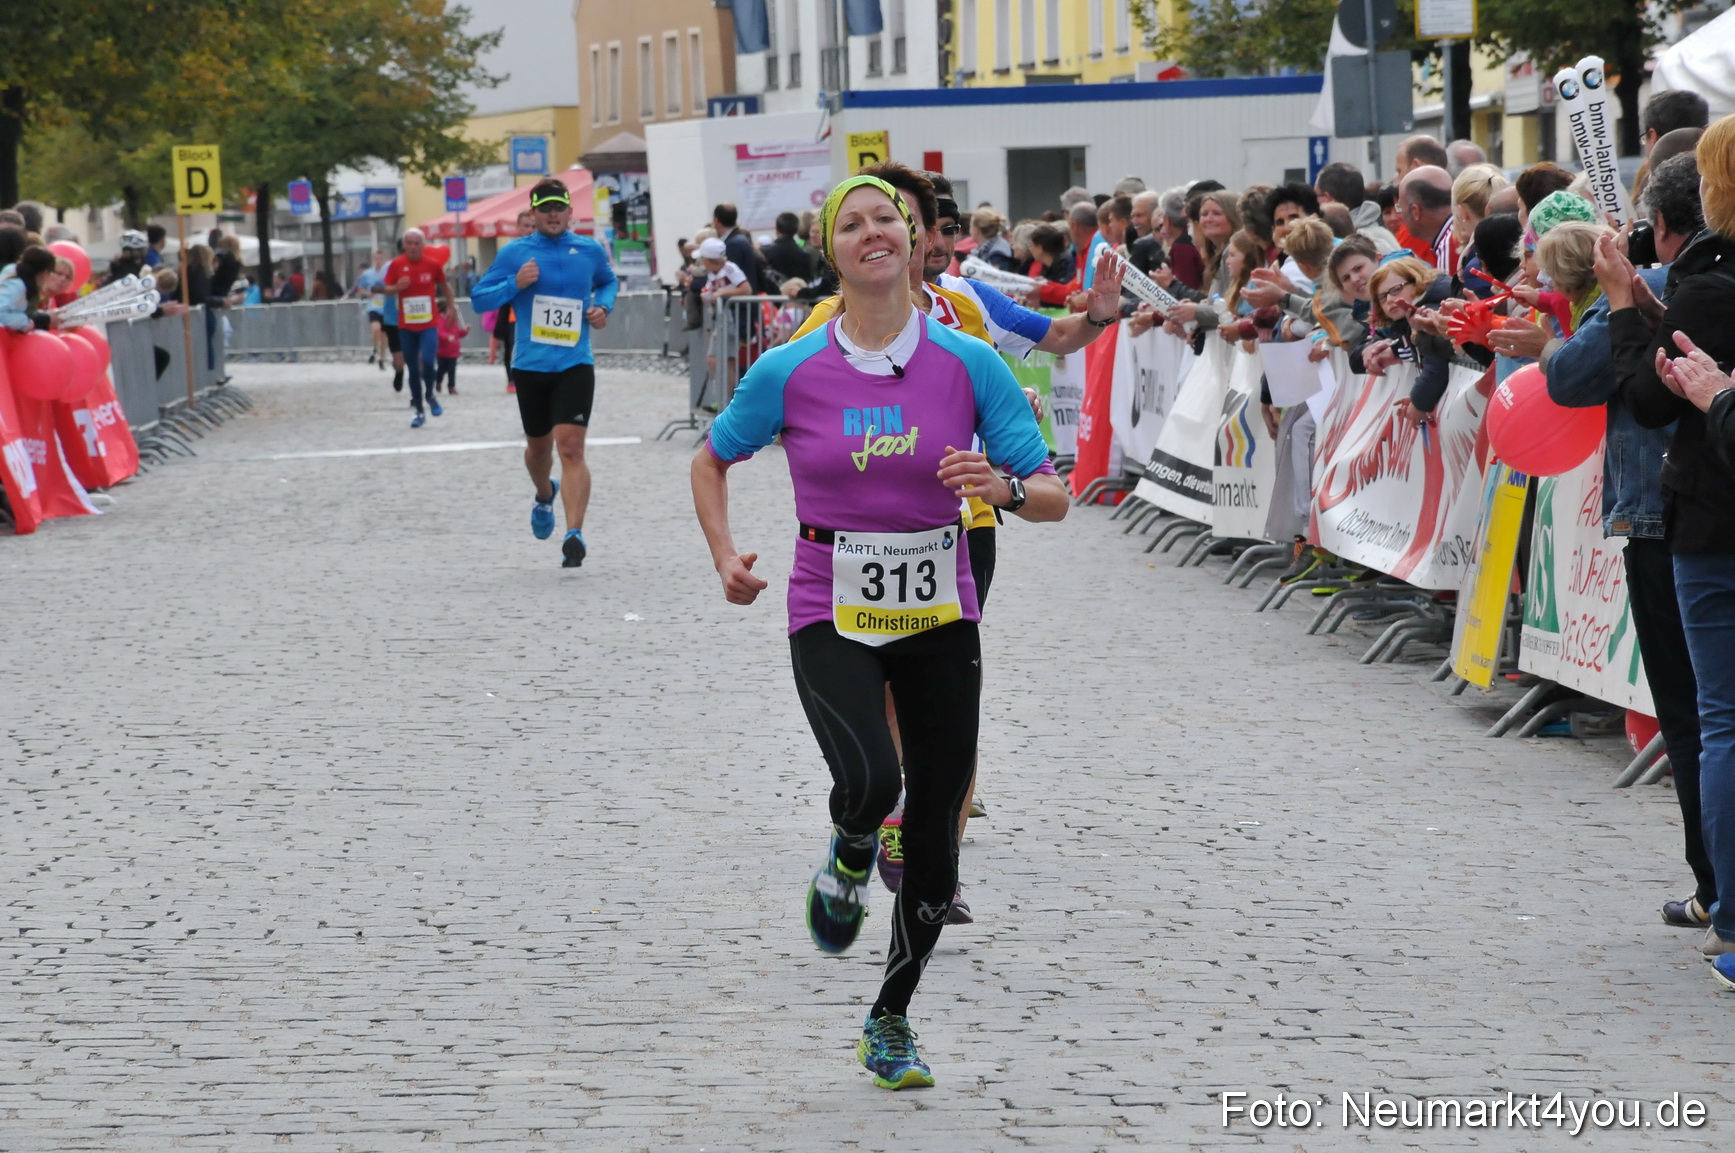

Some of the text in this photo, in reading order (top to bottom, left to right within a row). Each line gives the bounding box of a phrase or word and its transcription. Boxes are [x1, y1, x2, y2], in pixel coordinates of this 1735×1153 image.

[850, 133, 883, 147] Block
[179, 149, 213, 161] Block
[187, 167, 209, 198] D
[543, 308, 573, 328] 134
[540, 329, 572, 340] Wolfgang
[843, 404, 904, 436] RUN
[851, 425, 920, 472] fast
[837, 541, 939, 556] PARTL Neumarkt
[861, 559, 937, 603] 313
[856, 611, 940, 631] Christiane
